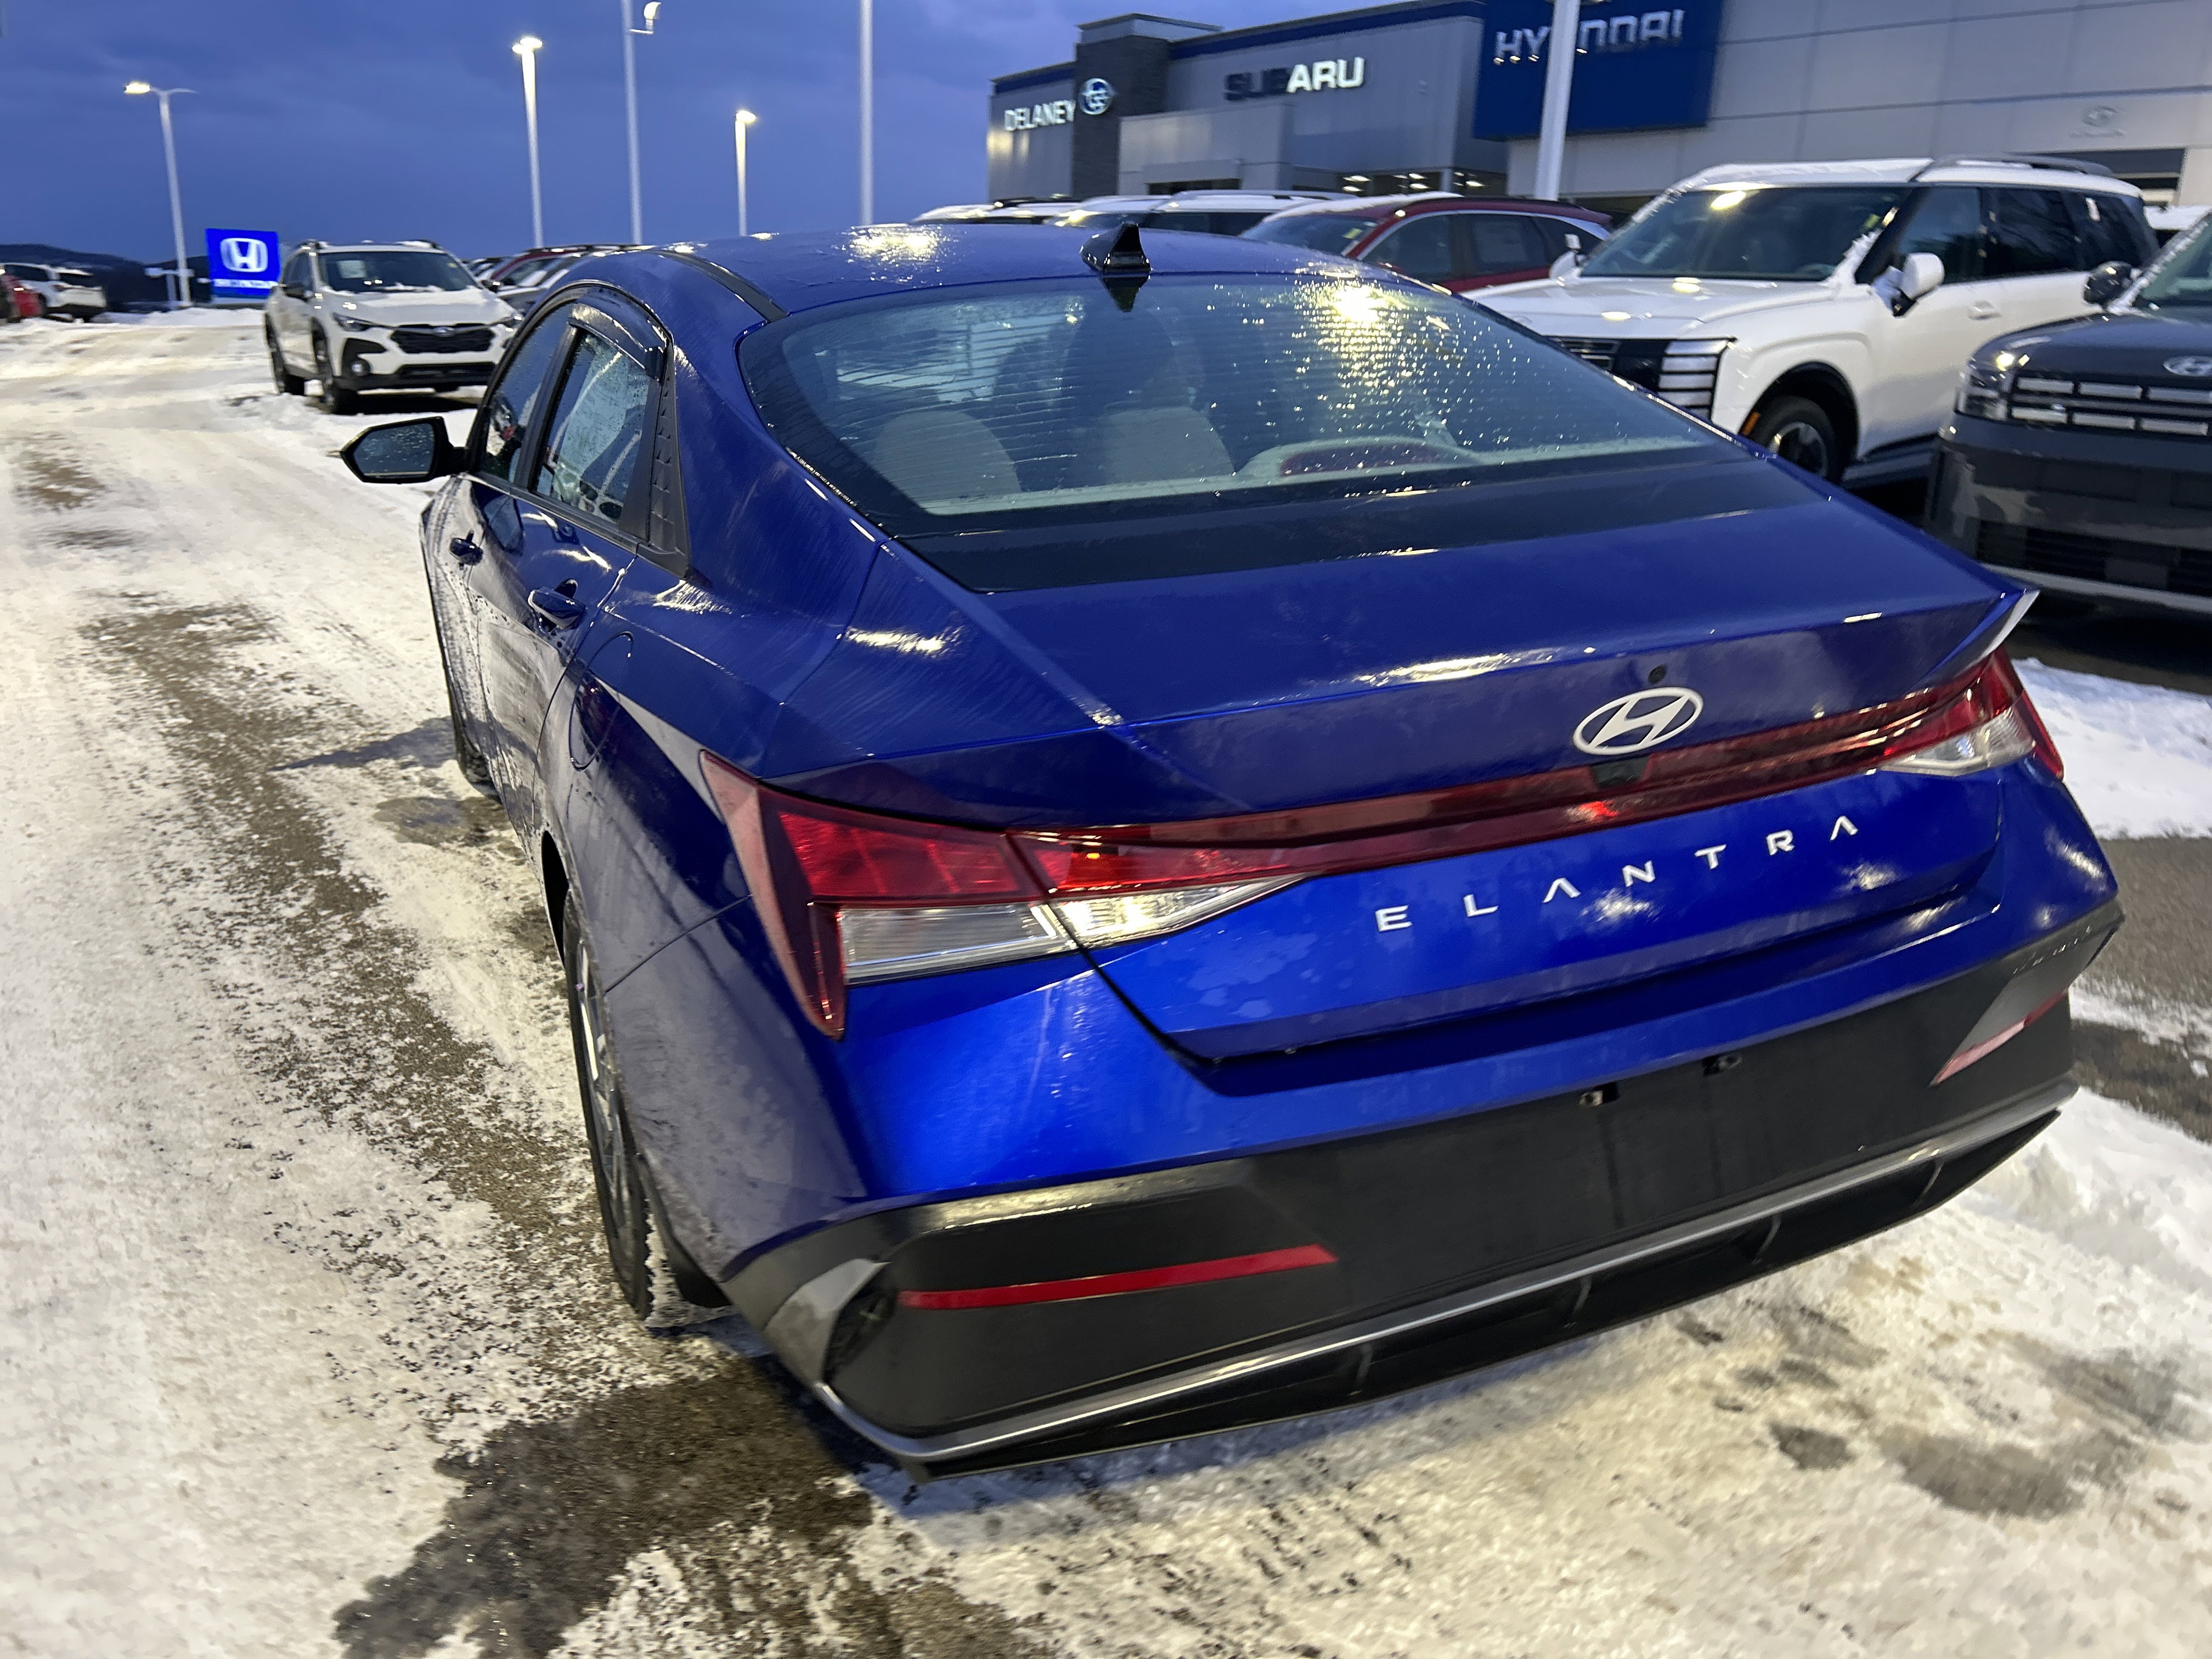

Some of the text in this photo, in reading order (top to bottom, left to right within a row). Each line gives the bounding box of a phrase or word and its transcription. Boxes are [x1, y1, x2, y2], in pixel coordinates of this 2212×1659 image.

[1494, 9, 1685, 58] HYNDAI
[1004, 100, 1076, 131] DELANEY
[1374, 815, 1858, 932] ELANTRA
